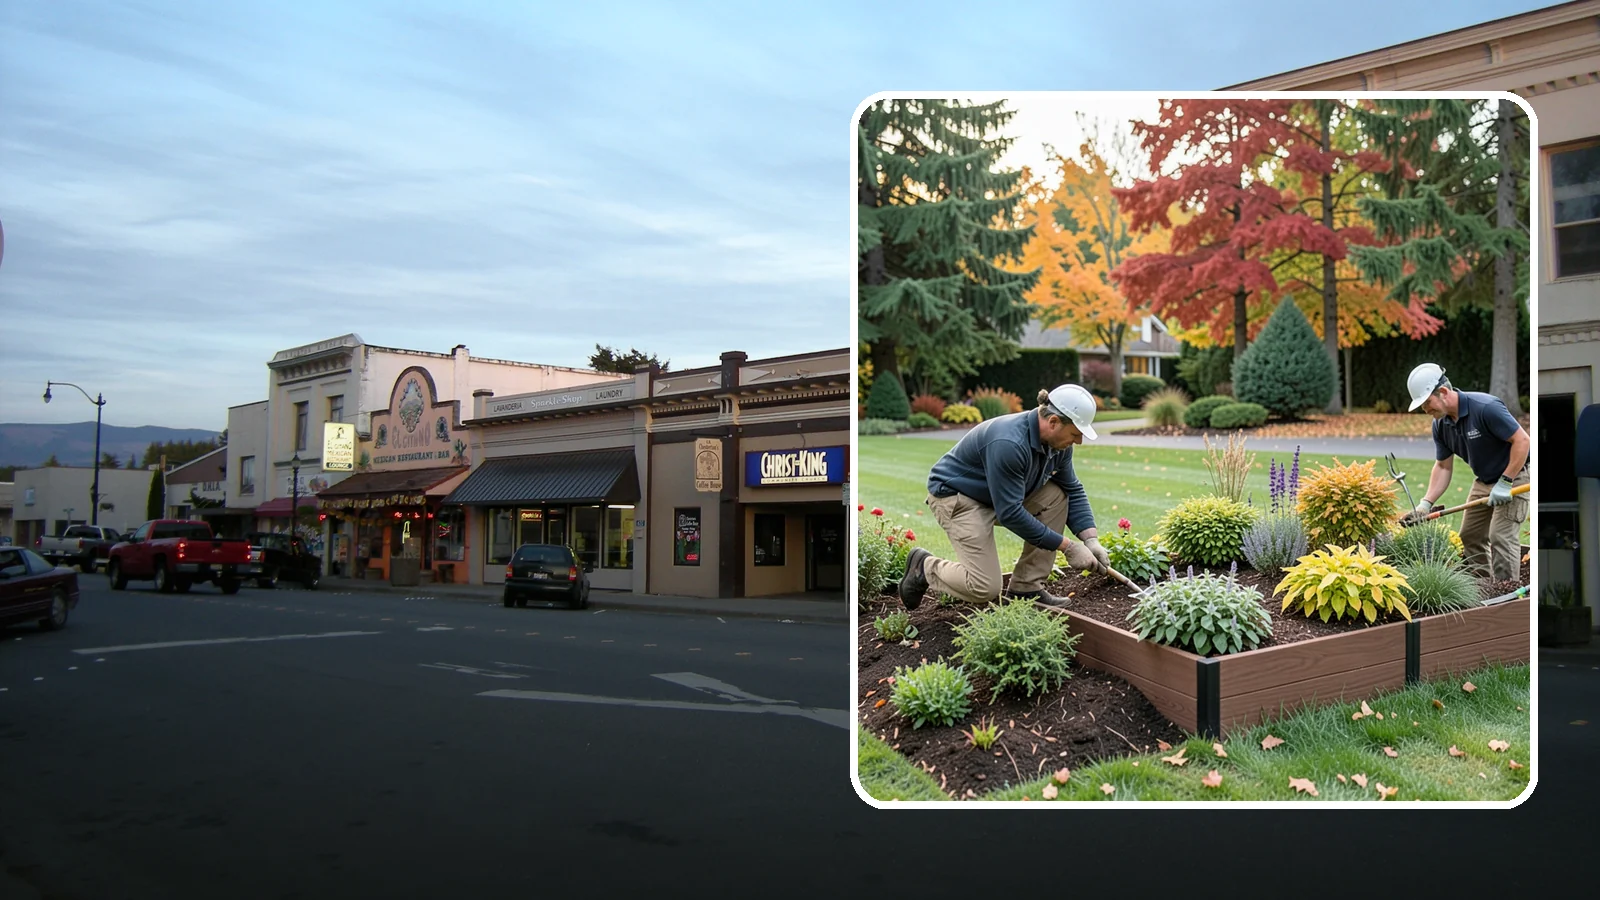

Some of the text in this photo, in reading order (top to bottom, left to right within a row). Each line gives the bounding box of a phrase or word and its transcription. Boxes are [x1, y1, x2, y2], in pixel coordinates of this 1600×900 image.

[493, 402, 522, 412] LAVANDERIA
[562, 394, 583, 405] Shop
[595, 389, 623, 399] LAUNDRY
[373, 456, 396, 464] MEXICAN
[397, 452, 433, 462] RESTAURANT
[437, 450, 450, 459] BAR
[696, 481, 709, 489] Coffee
